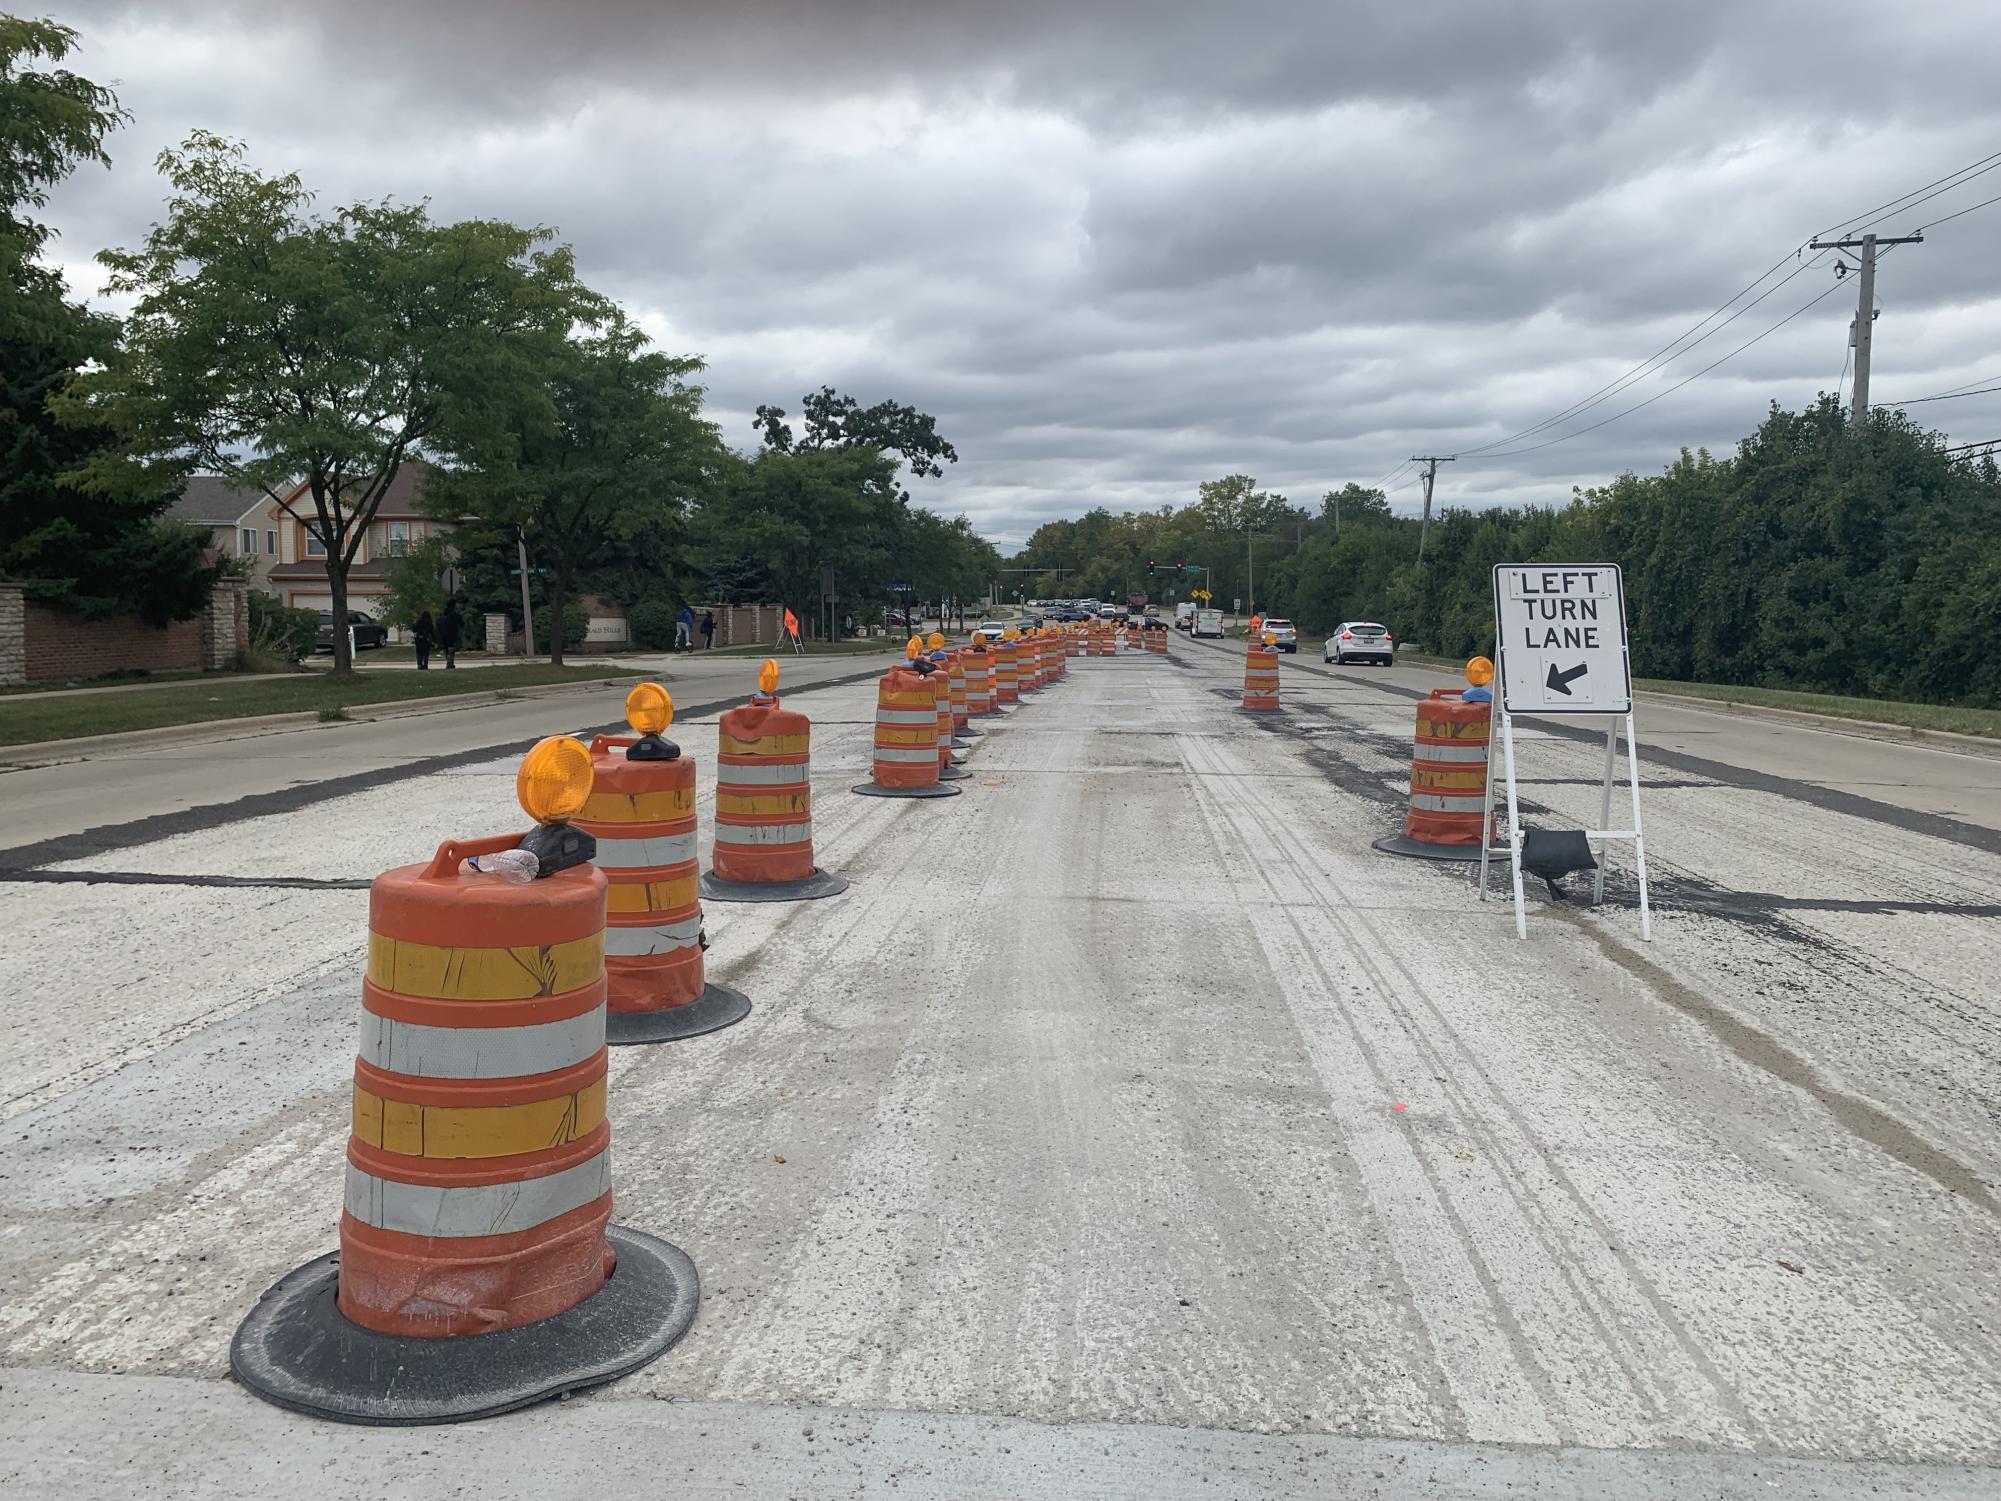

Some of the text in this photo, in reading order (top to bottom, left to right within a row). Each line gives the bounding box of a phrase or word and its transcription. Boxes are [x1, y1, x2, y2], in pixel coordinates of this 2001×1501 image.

[1521, 572, 1598, 594] LEFT
[1522, 599, 1598, 620] TURN
[1525, 627, 1600, 649] LANE
